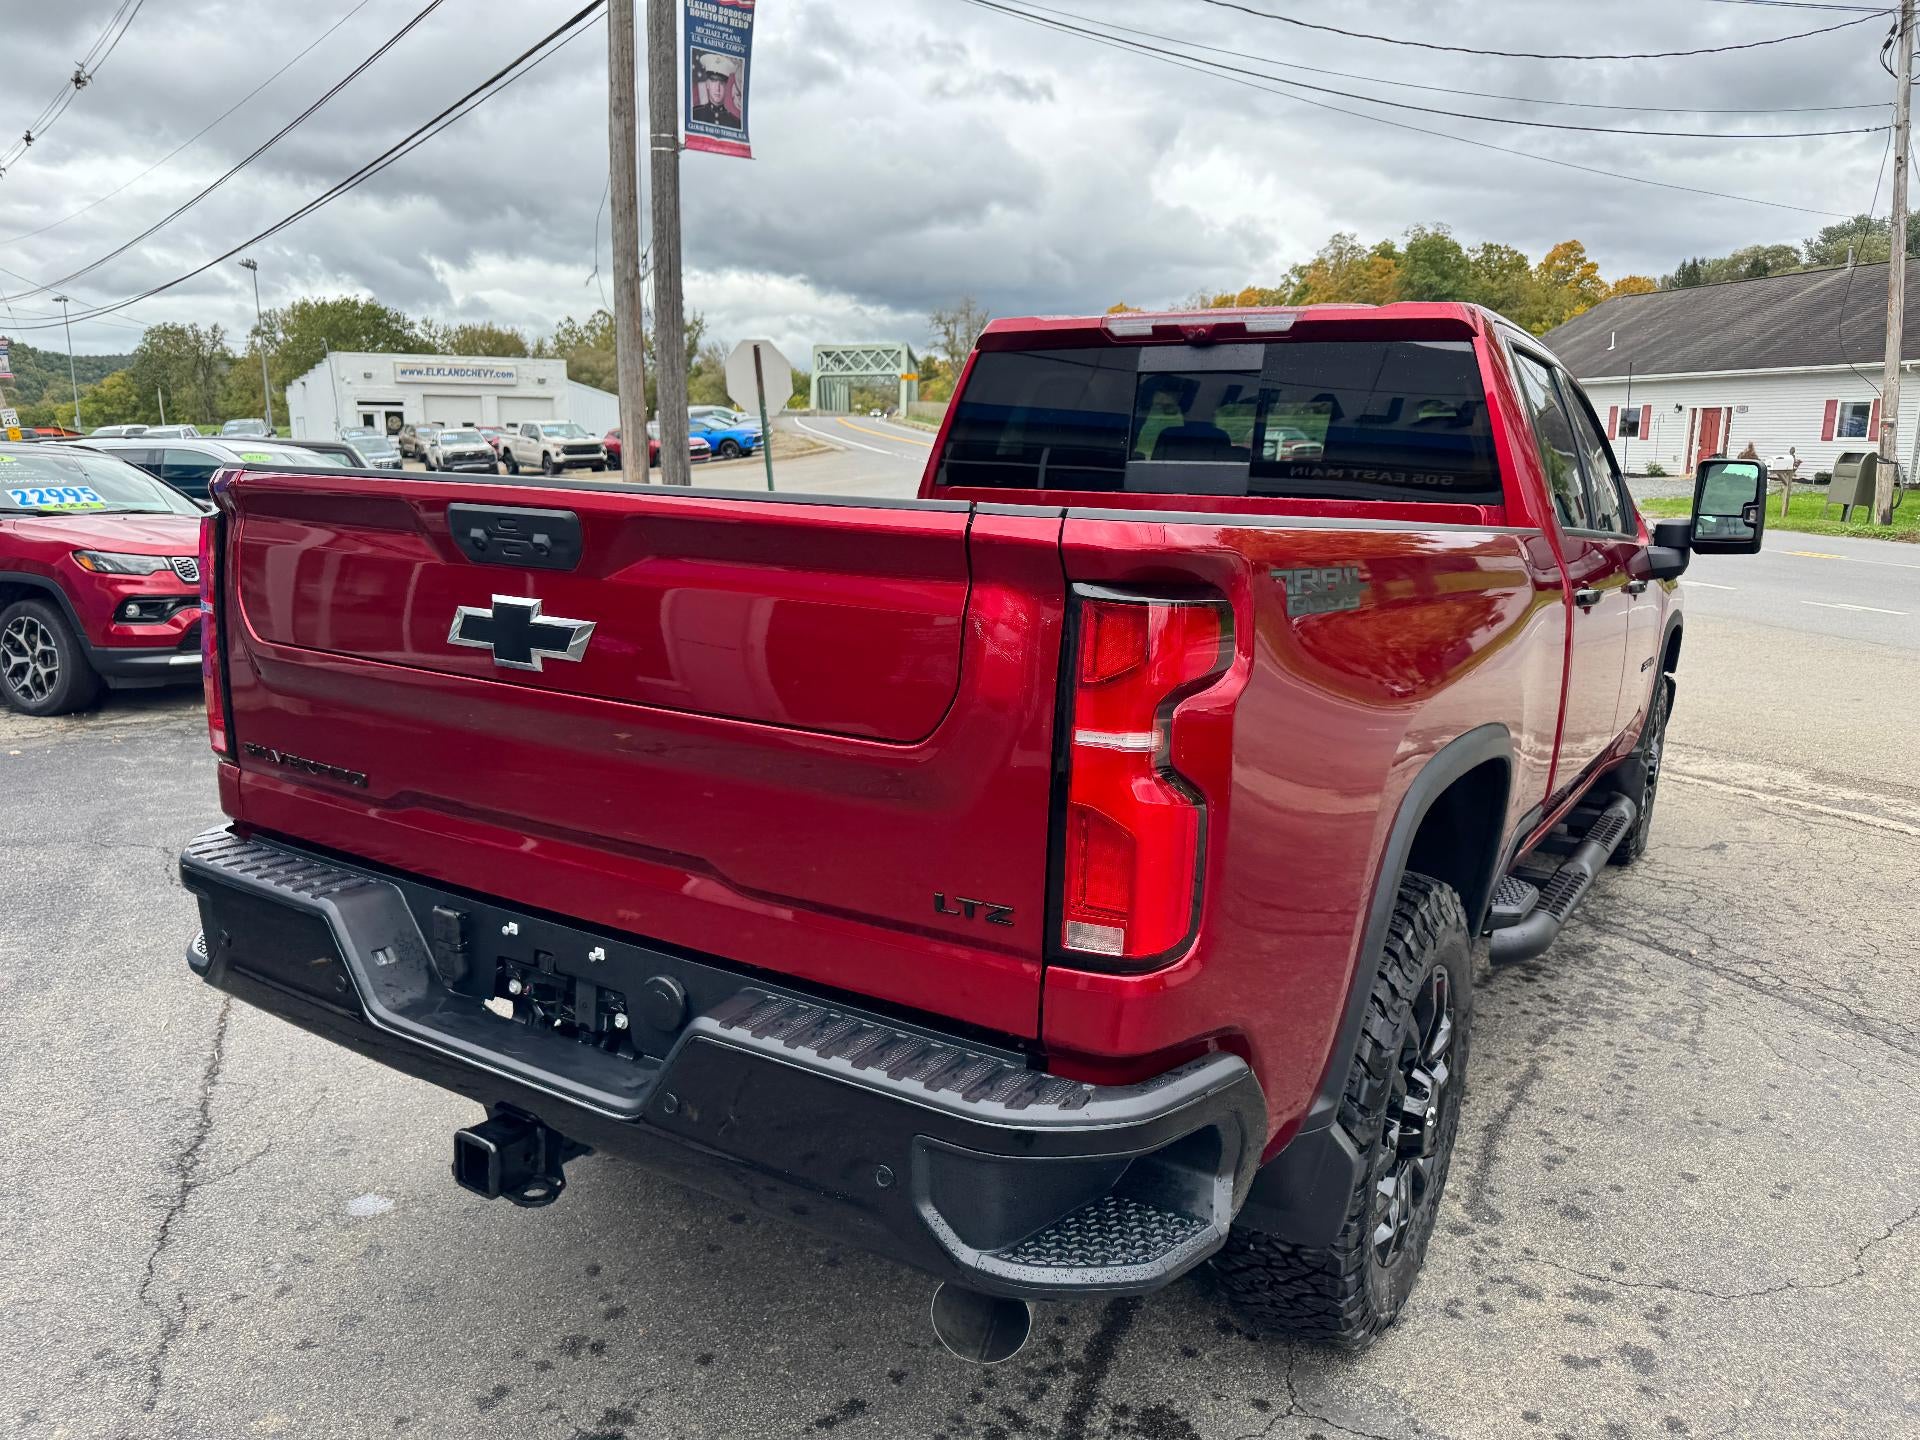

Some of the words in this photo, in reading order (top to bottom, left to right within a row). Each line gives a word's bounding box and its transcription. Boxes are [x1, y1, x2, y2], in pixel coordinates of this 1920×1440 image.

[690, 8, 728, 24] HOMETOWN
[729, 17, 749, 29] HERO
[718, 6, 752, 22] BOROUGH
[400, 367, 514, 379] www.ELKLANDCHEVY.com
[5, 417, 17, 425] 40
[11, 487, 98, 506] 22995
[934, 892, 1014, 927] LTZ
